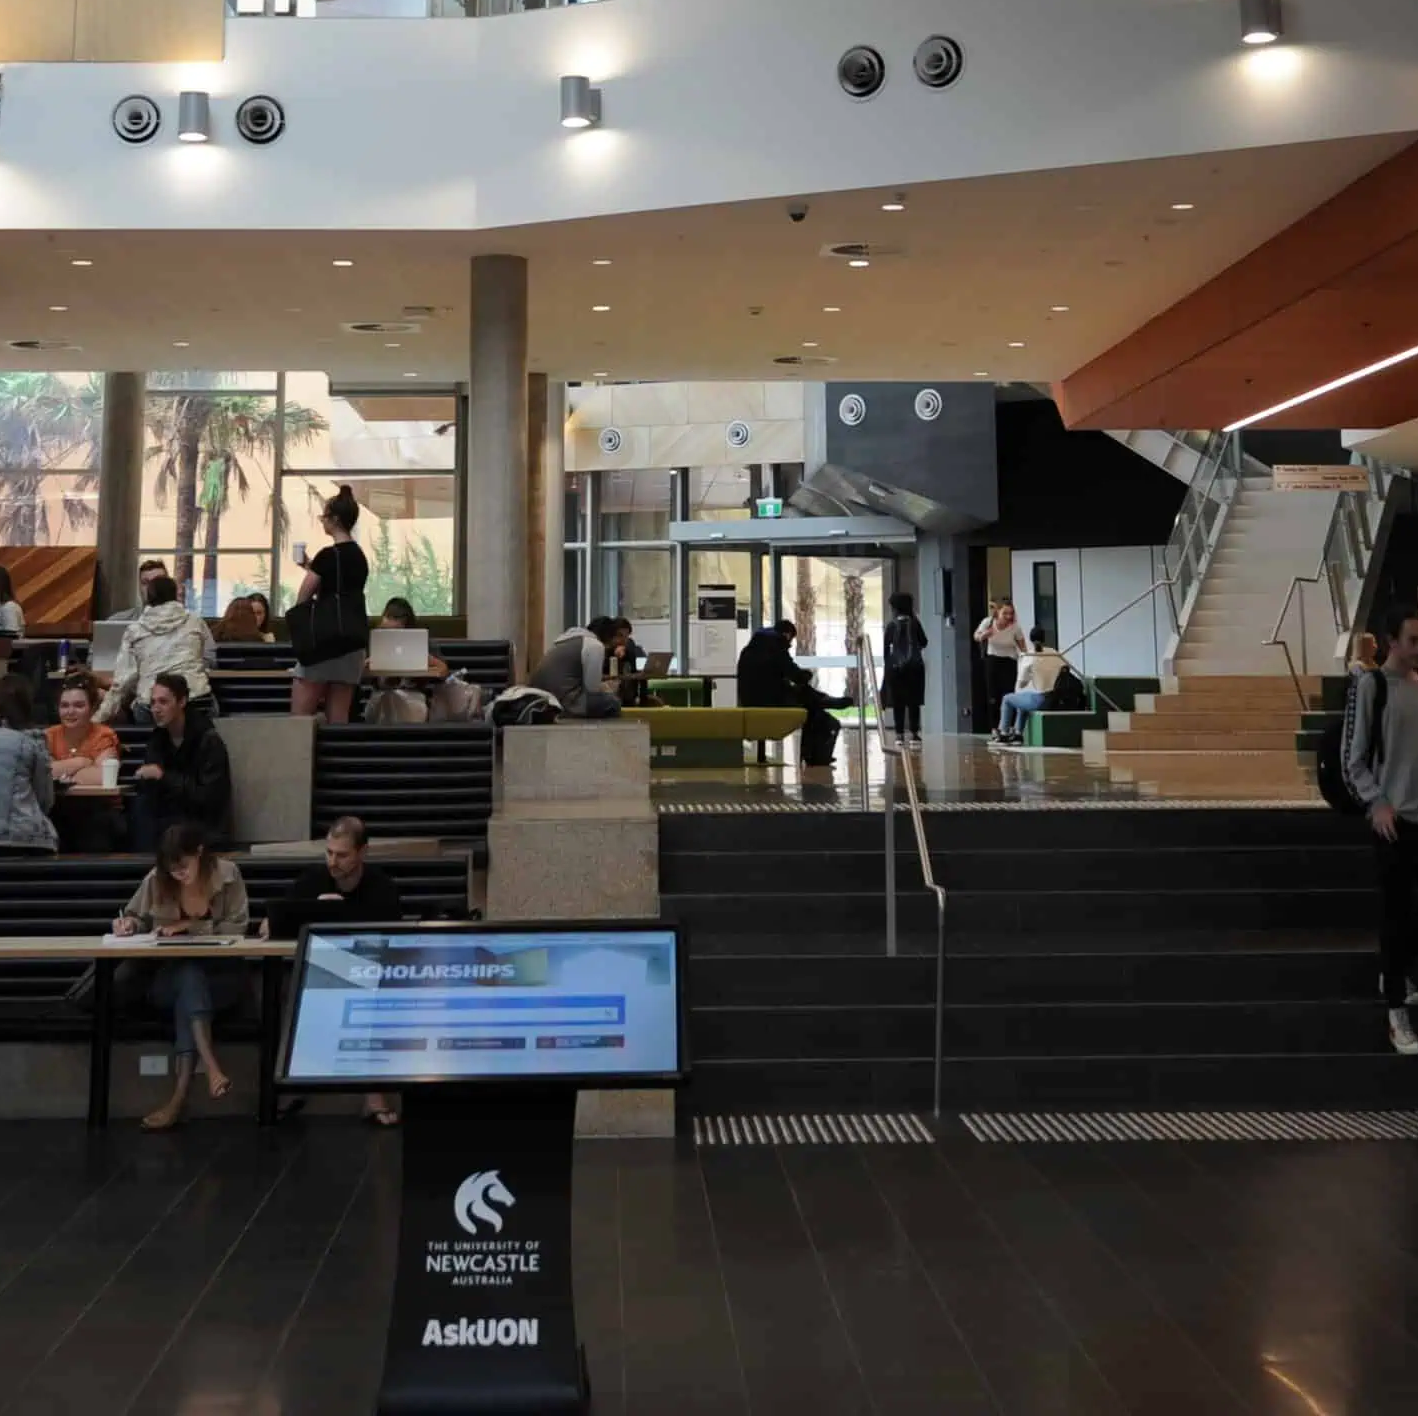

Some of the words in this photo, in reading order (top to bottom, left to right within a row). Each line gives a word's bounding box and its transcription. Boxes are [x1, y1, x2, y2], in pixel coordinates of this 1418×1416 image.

[349, 962, 516, 981] SCHOLARSHIPS
[427, 1240, 449, 1251] THE
[454, 1240, 521, 1251] UNIVERSITY
[525, 1240, 541, 1251] OF
[426, 1254, 540, 1273] NEWCASTLE
[452, 1275, 513, 1286] AUSTRALIA
[422, 1316, 539, 1347] AskUON
